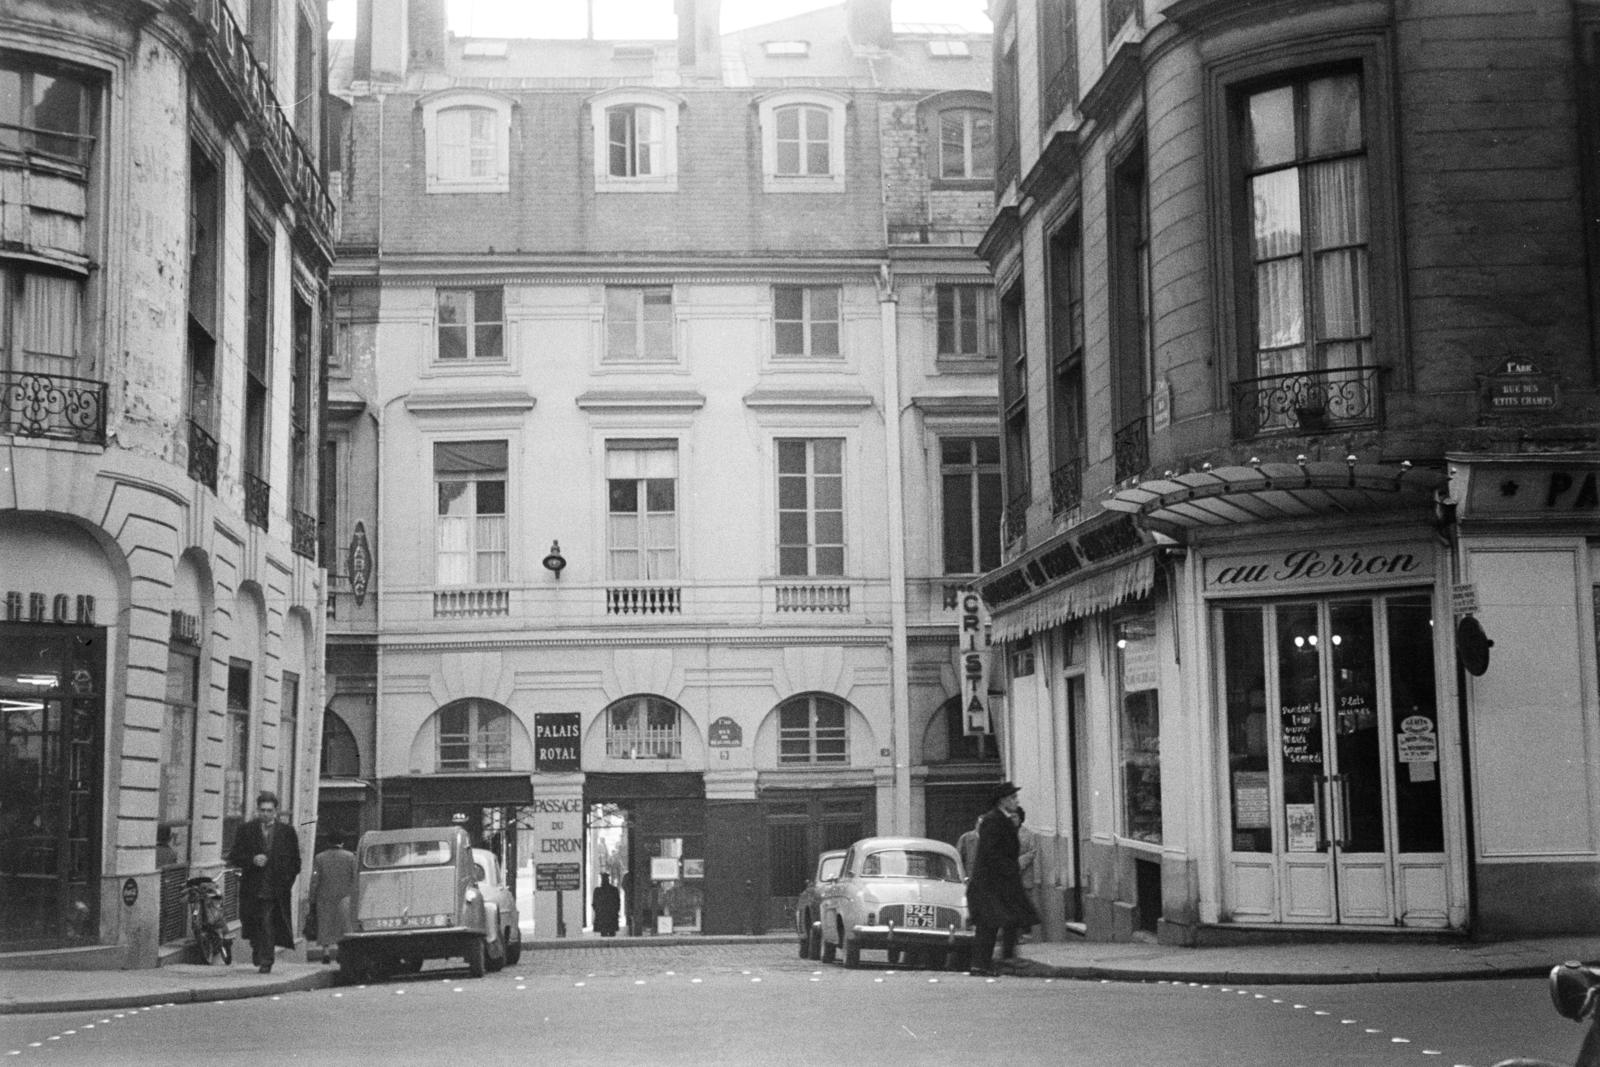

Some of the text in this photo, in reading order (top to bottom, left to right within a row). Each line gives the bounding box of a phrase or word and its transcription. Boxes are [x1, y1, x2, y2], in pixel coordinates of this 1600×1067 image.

[1520, 396, 1553, 405] CHAMPS
[353, 532, 366, 595] TABAC
[1273, 550, 1423, 581] Perron
[963, 594, 985, 732] CRISTAL
[536, 725, 580, 738] PALAIS
[539, 747, 577, 761] ROYAL
[534, 799, 582, 813] PASSAGE
[552, 821, 564, 830] DU
